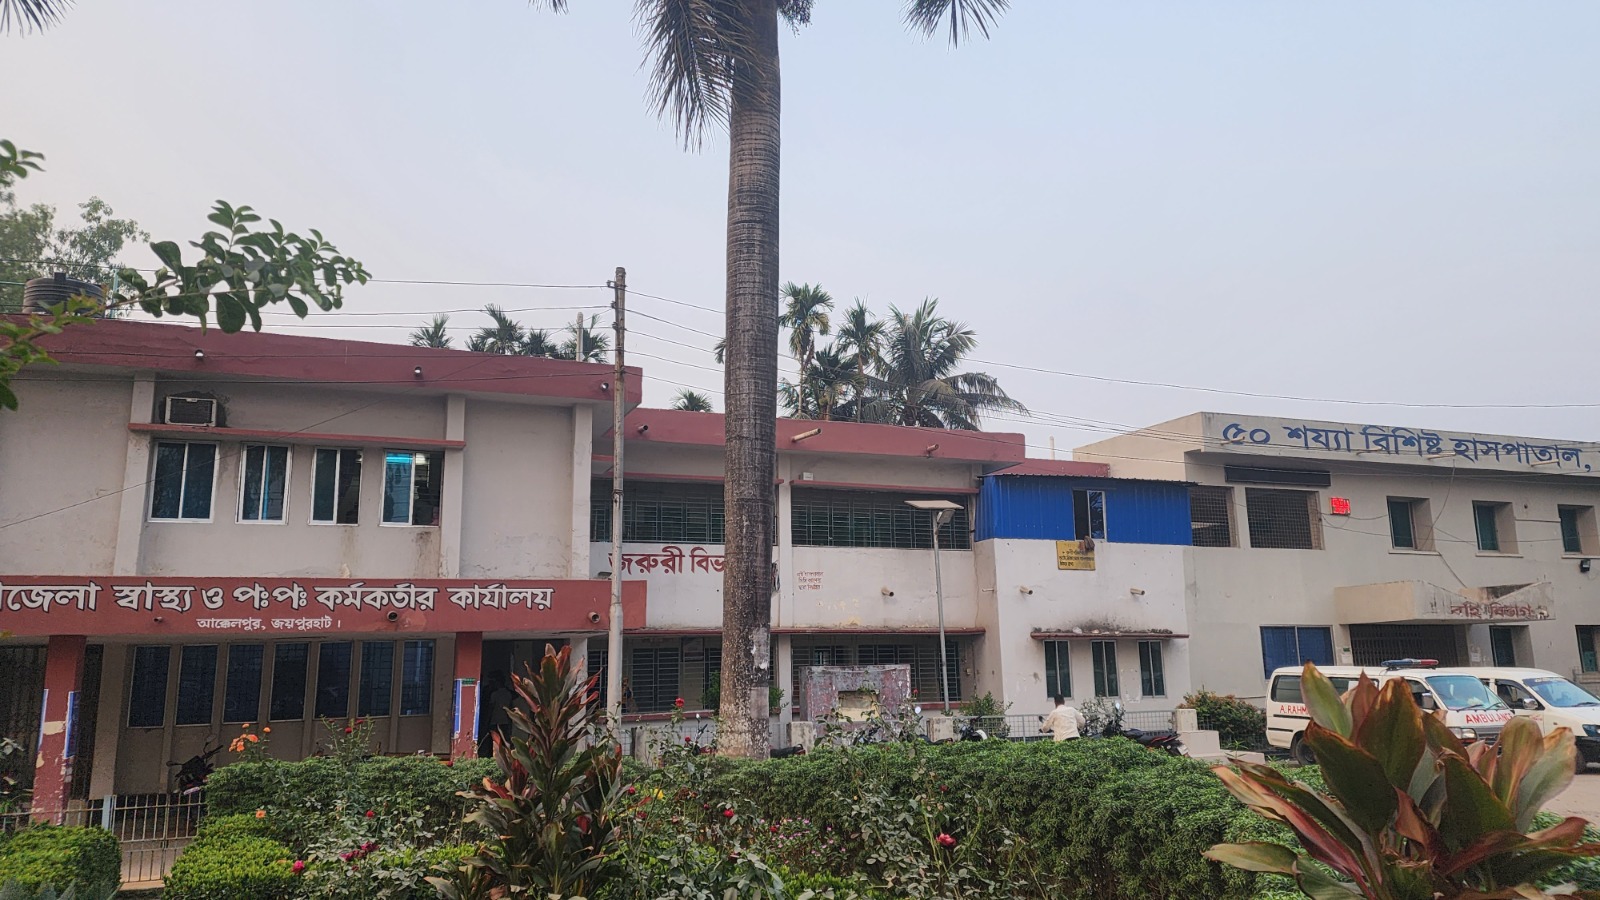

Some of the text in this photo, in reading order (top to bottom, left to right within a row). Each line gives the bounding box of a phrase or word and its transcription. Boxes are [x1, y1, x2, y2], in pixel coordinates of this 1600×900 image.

[1222, 423, 1271, 445] ৫০
[1282, 424, 1354, 452] শয্যা
[689, 546, 725, 574] বিভ
[111, 580, 197, 613] স্বাস্থ্য
[201, 585, 225, 611] ও
[314, 582, 439, 612] কর্মকর্তার
[446, 583, 556, 611] কার্যালয়
